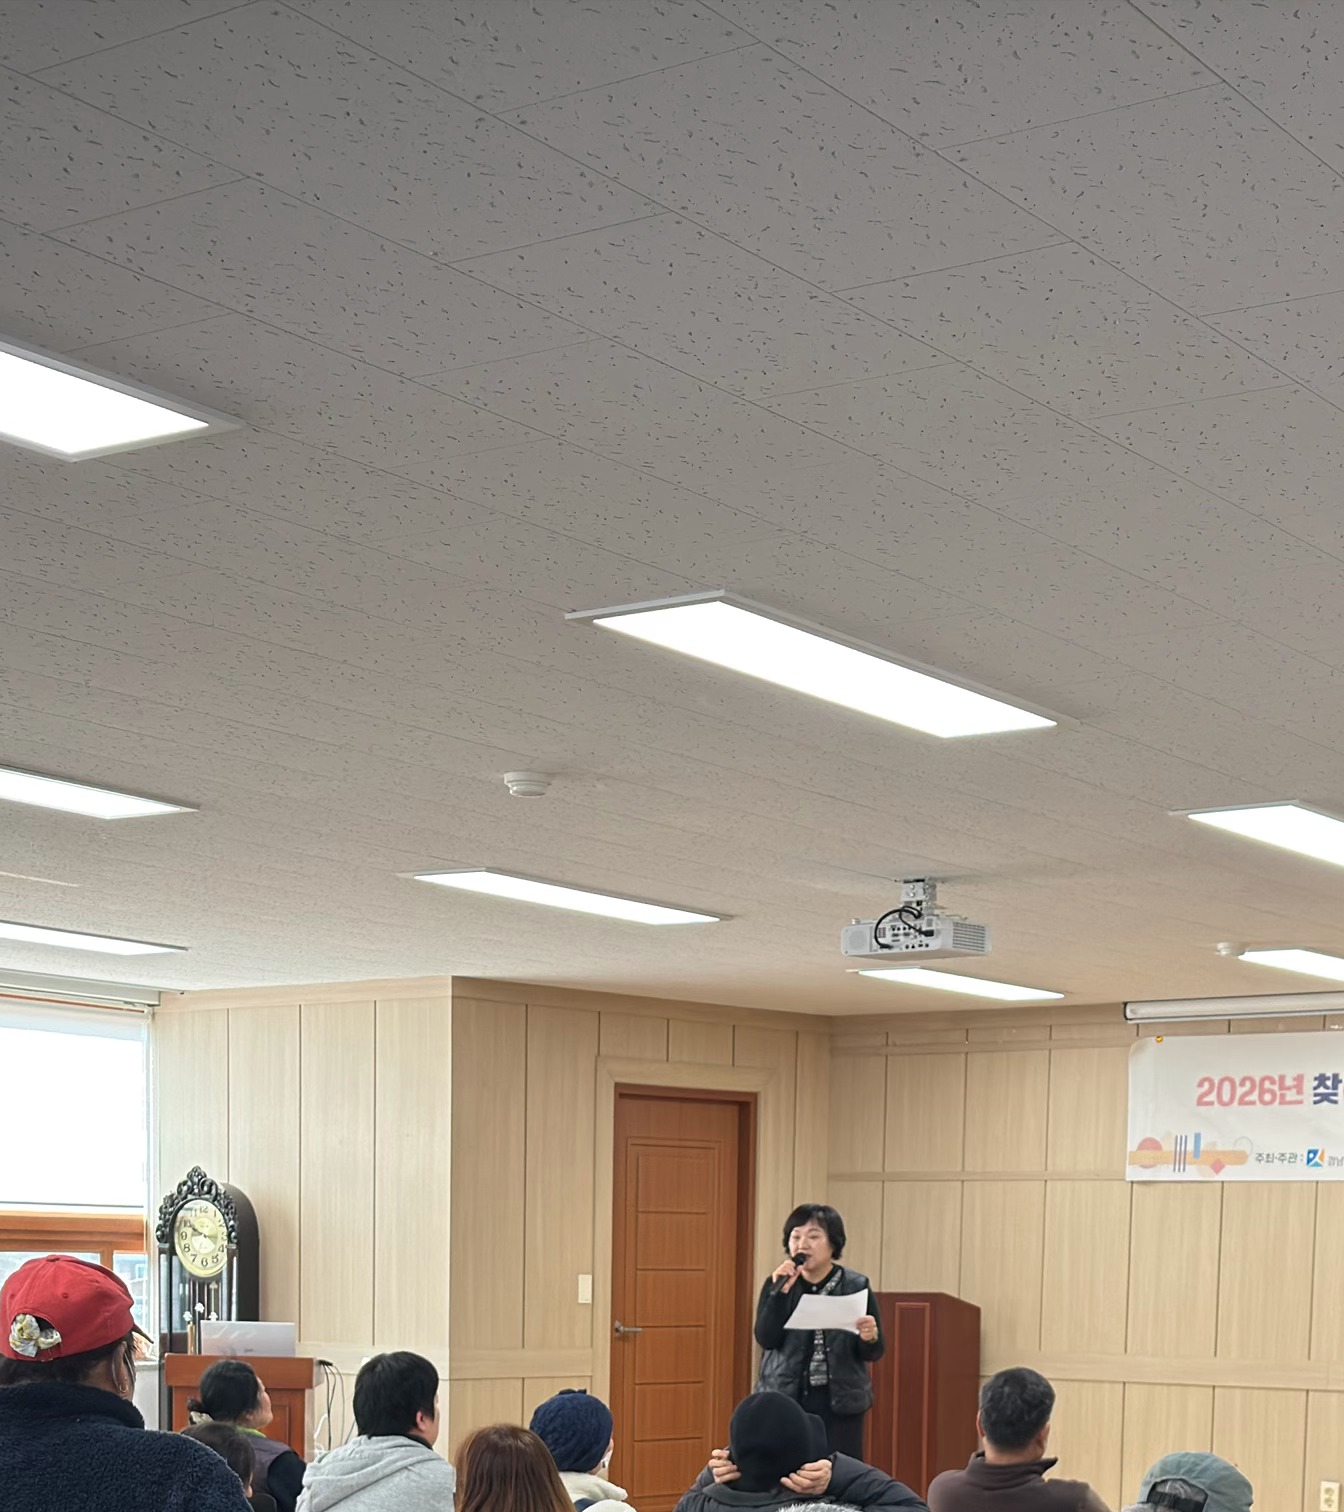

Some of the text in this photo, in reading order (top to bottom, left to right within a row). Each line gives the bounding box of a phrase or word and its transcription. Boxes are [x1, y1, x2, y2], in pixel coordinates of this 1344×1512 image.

[1196, 1073, 1305, 1107] 2026년
[180, 1231, 187, 1240] 9
[183, 1243, 190, 1252] 8
[218, 1244, 224, 1253] 4
[190, 1254, 197, 1263] 7
[201, 1257, 208, 1267] 6
[211, 1253, 219, 1263] 5
